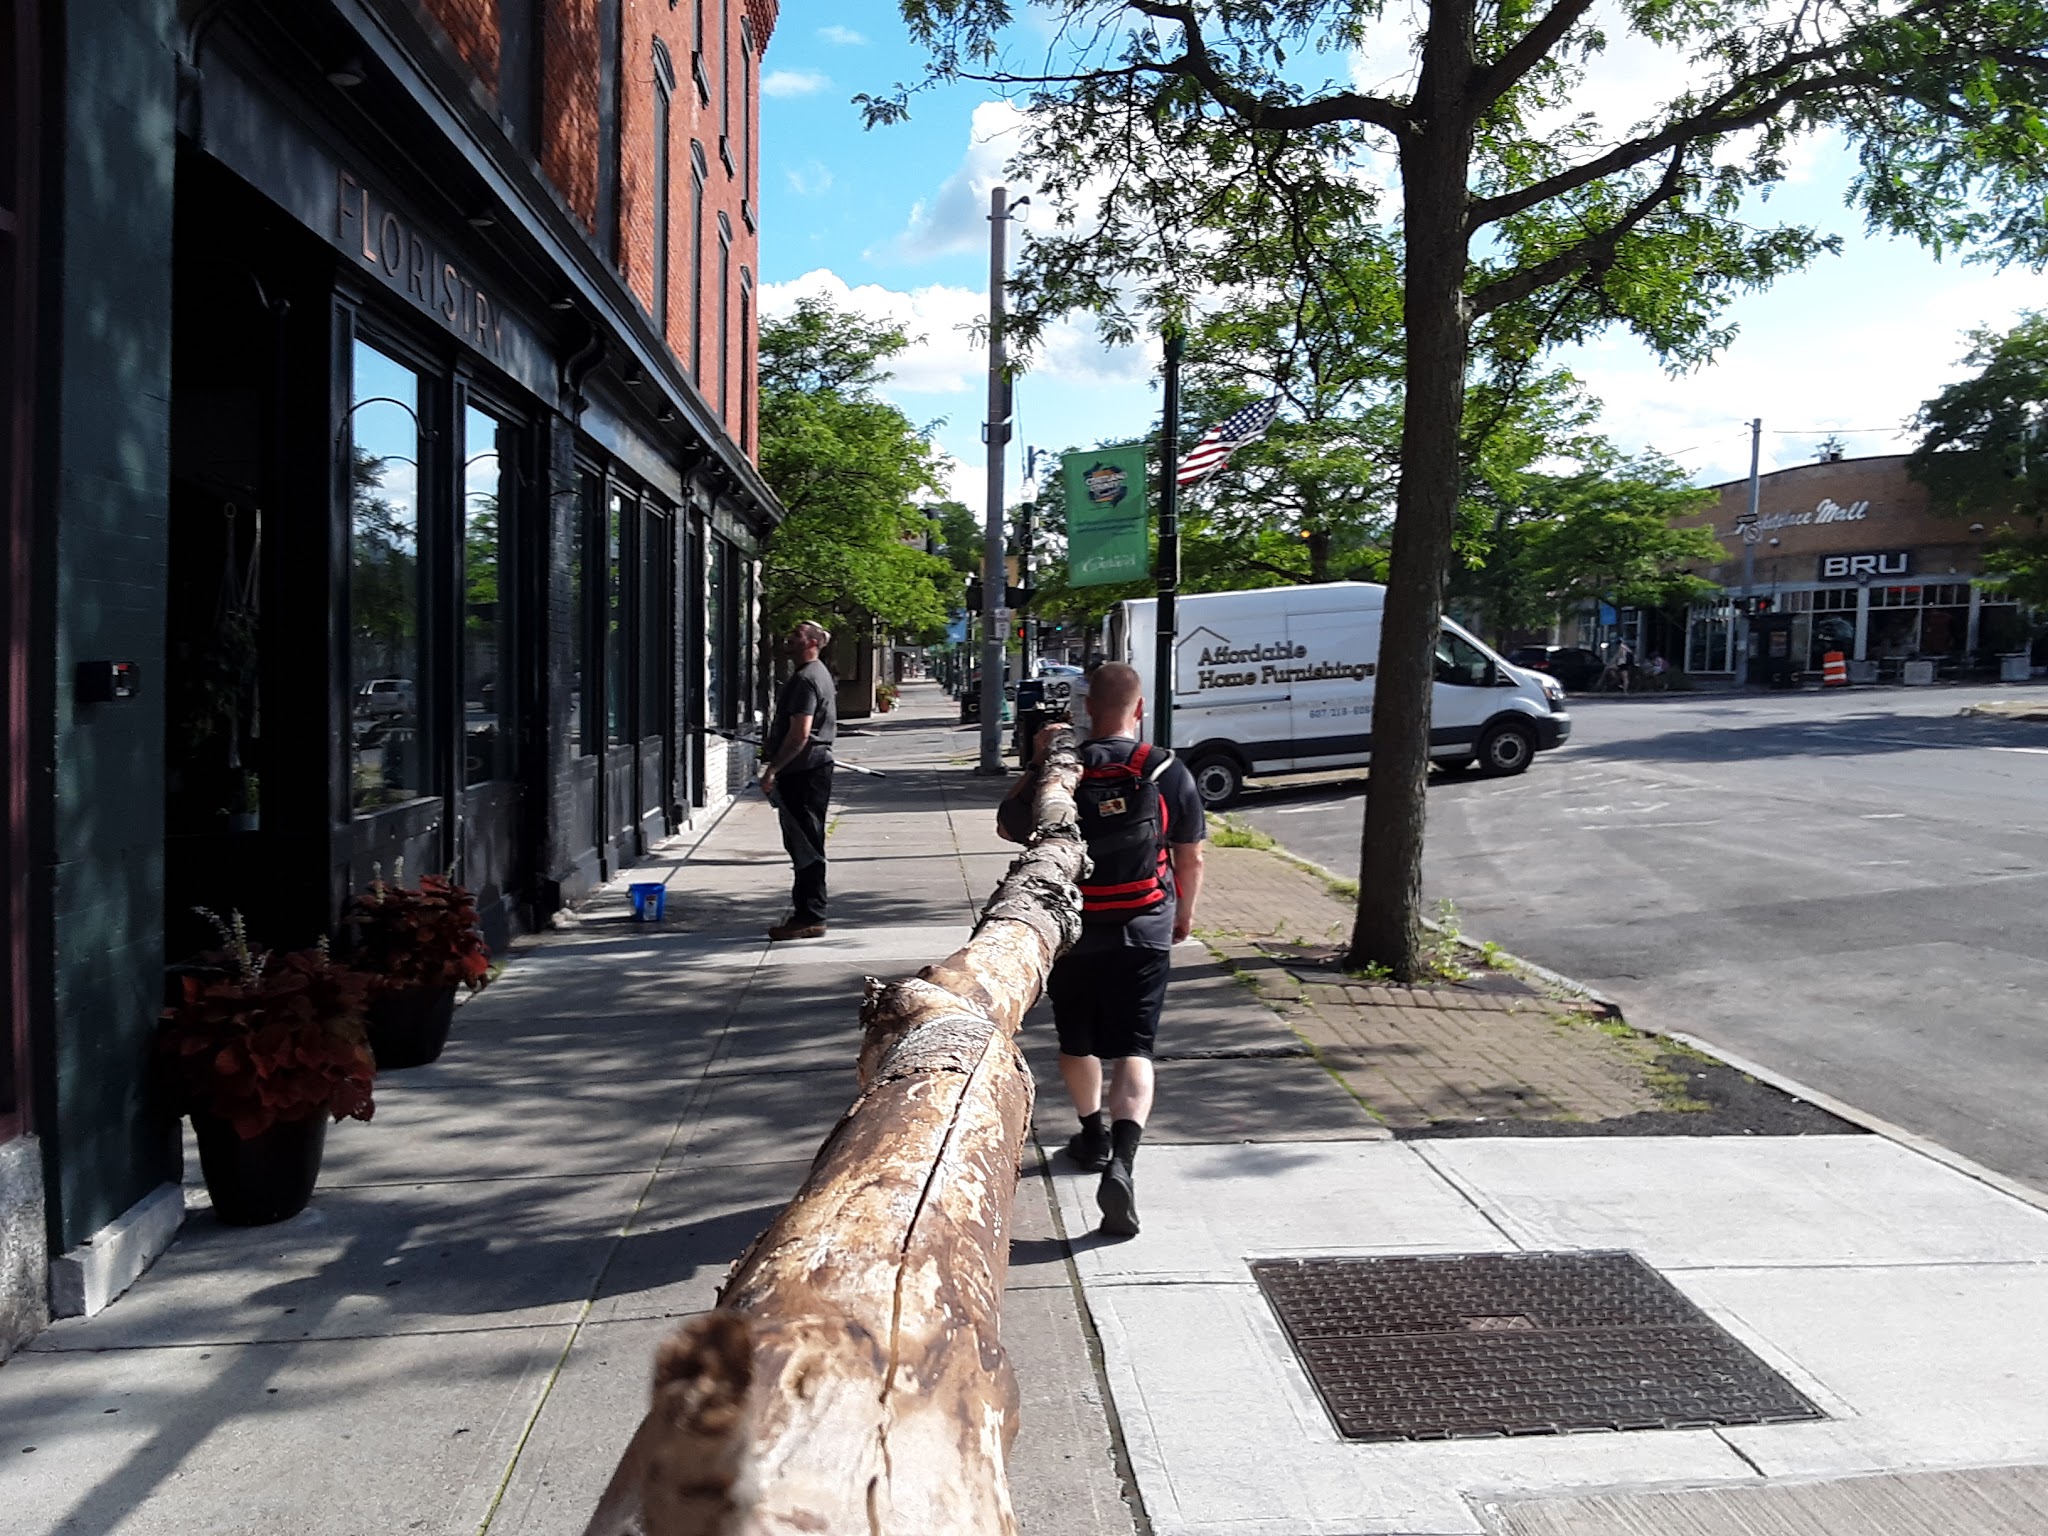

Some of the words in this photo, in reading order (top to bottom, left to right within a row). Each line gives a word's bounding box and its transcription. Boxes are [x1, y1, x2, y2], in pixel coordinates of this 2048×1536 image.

[337, 169, 502, 358] FLORISTRY
[1814, 498, 1869, 524] Mall
[1824, 553, 1908, 577] BRU
[1198, 640, 1307, 667] Affordable
[1198, 669, 1257, 689] Home
[1261, 661, 1376, 684] Furnishings
